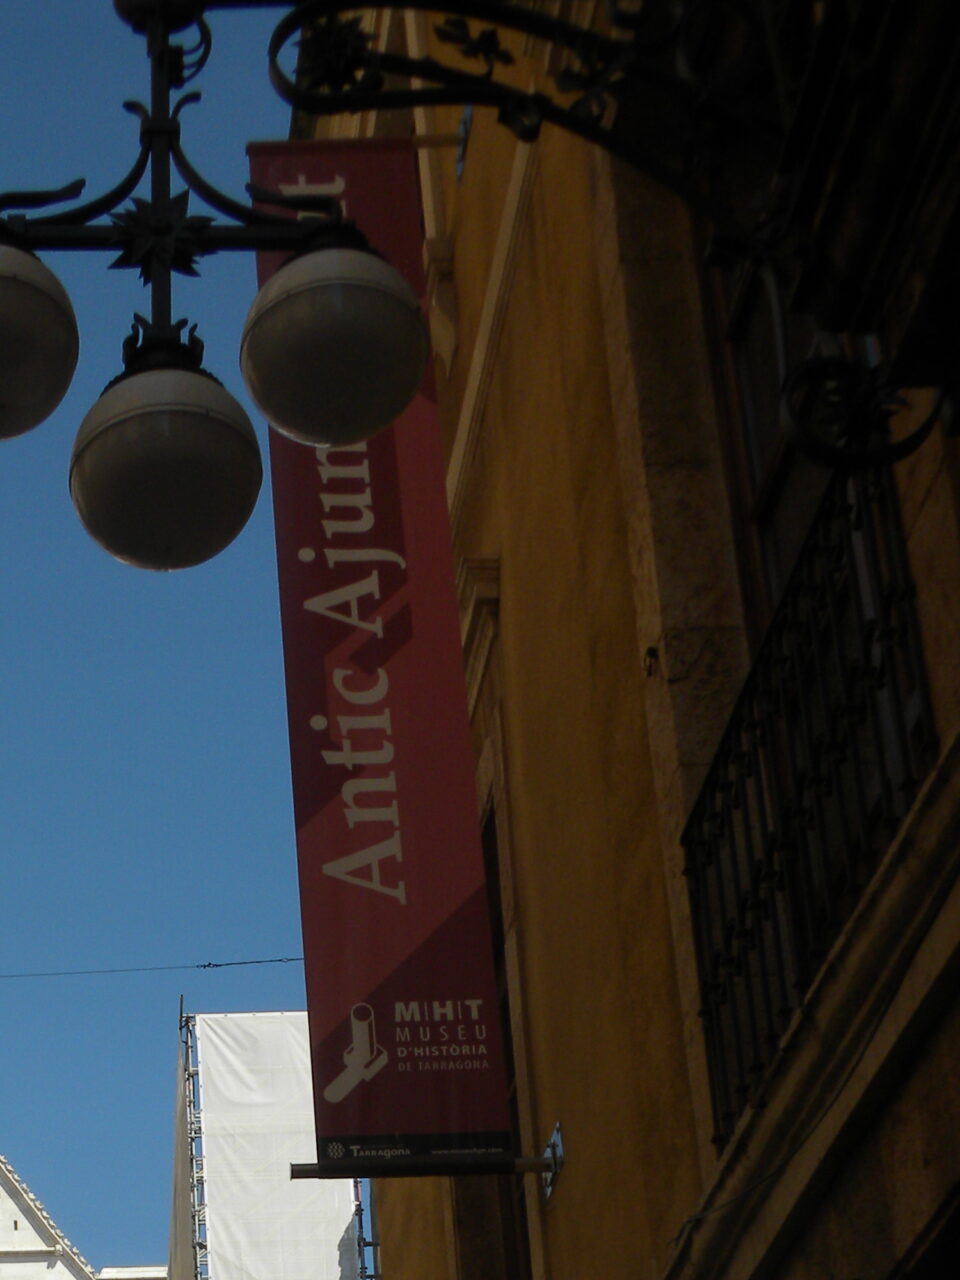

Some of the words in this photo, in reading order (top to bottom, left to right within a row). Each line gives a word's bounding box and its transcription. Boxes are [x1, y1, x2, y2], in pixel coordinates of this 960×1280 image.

[309, 667, 407, 905] Antic
[395, 1024, 487, 1042] MUSEU
[398, 1062, 413, 1072] DE
[418, 1059, 489, 1072] TARRAGONA
